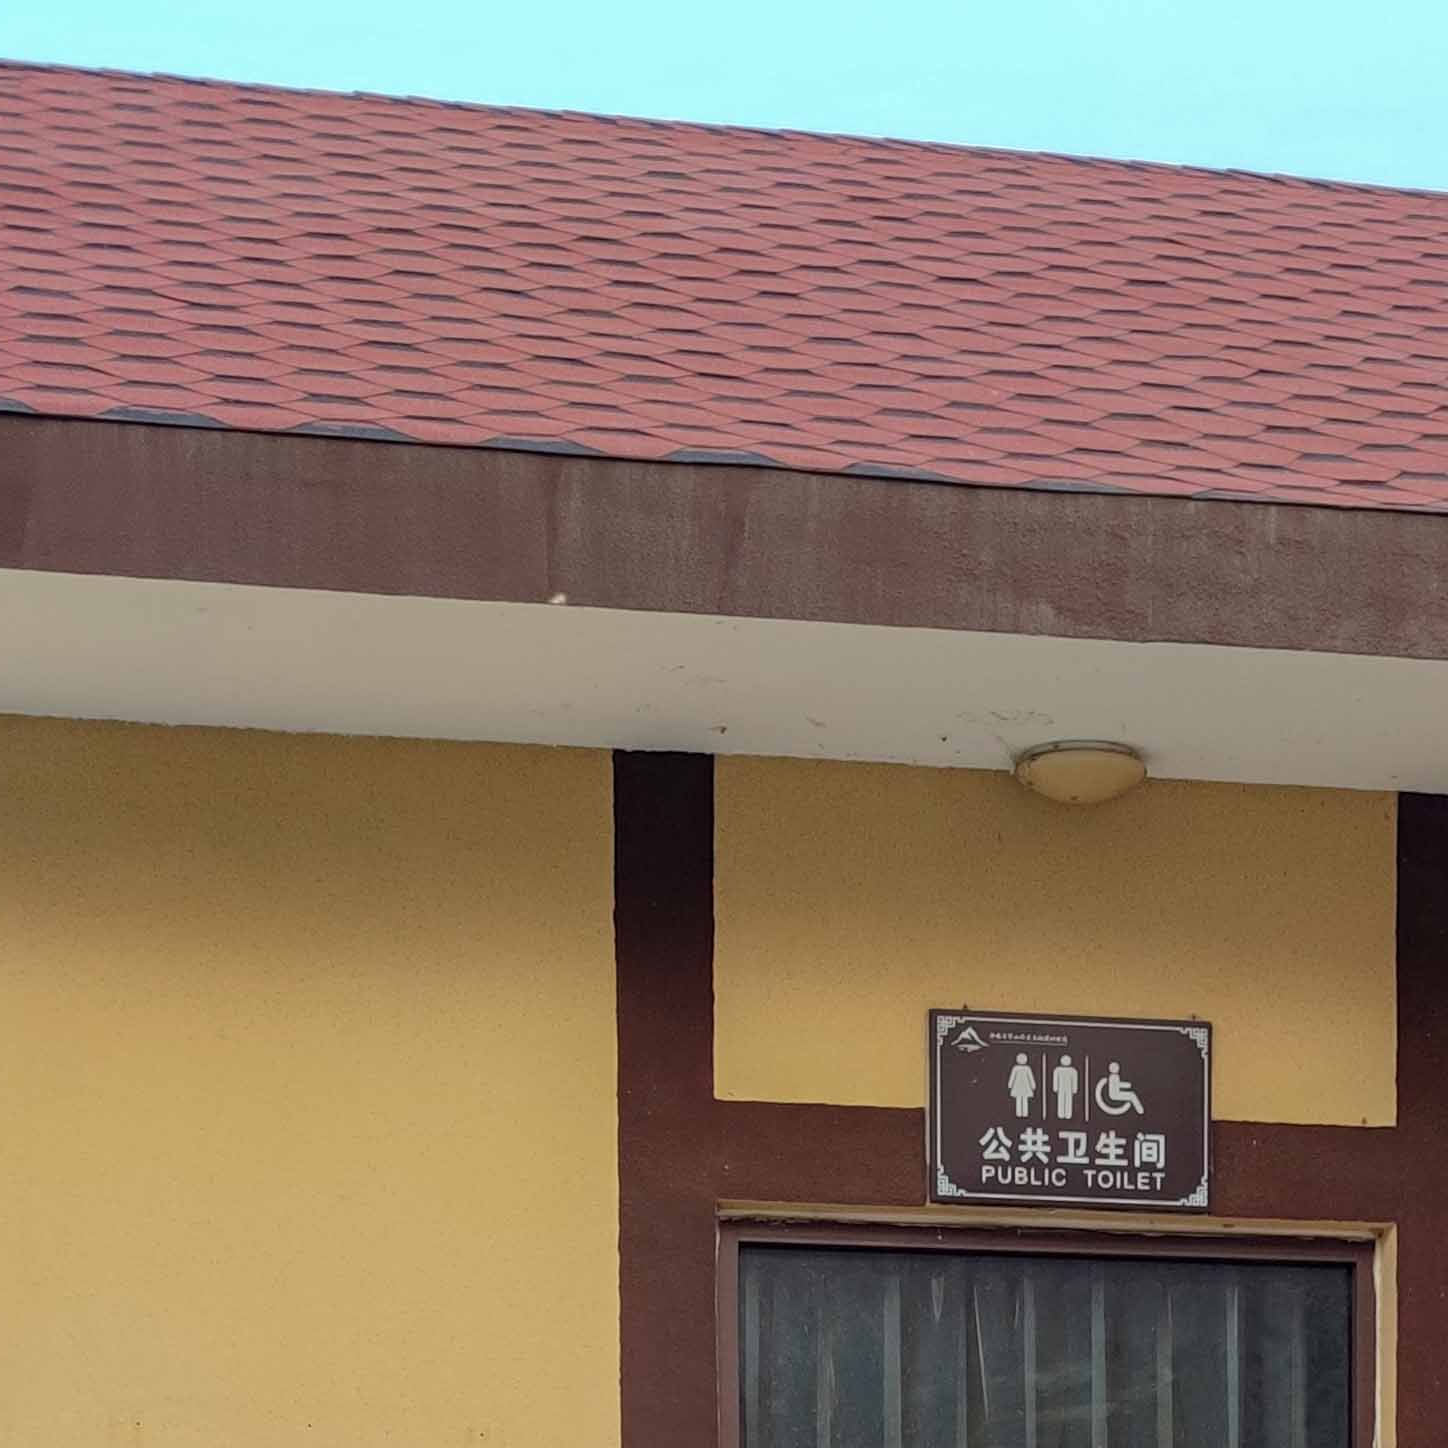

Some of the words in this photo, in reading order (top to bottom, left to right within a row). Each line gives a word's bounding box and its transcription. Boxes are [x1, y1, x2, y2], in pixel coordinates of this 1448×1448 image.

[978, 1126, 1166, 1169] 公共卫生间
[981, 1165, 1067, 1187] PUBLIC
[1083, 1169, 1166, 1190] TOILET
